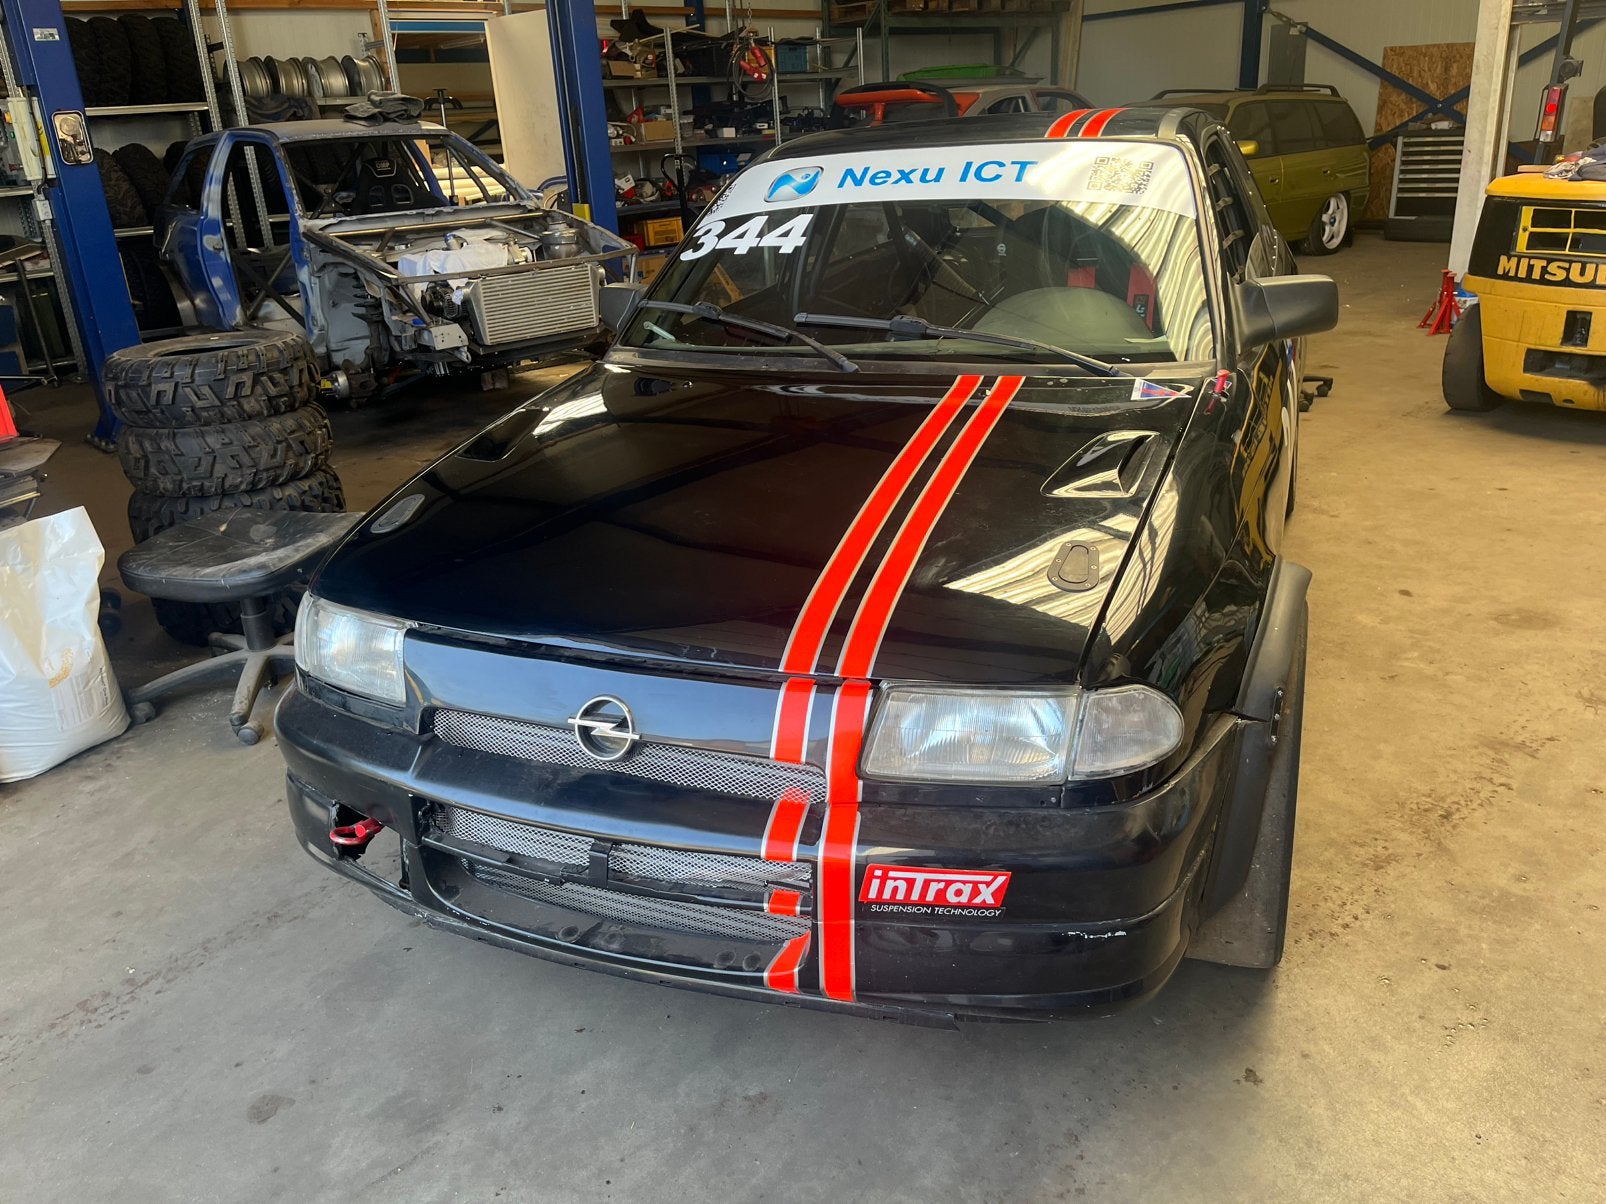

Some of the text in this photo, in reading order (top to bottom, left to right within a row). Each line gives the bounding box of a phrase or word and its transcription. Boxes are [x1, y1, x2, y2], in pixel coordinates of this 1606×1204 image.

[837, 160, 1039, 189] Nexu ICT
[680, 213, 814, 261] 344
[867, 869, 1007, 904] inTrax
[870, 904, 1002, 917] SUSPENSION TECHNOLOGY
